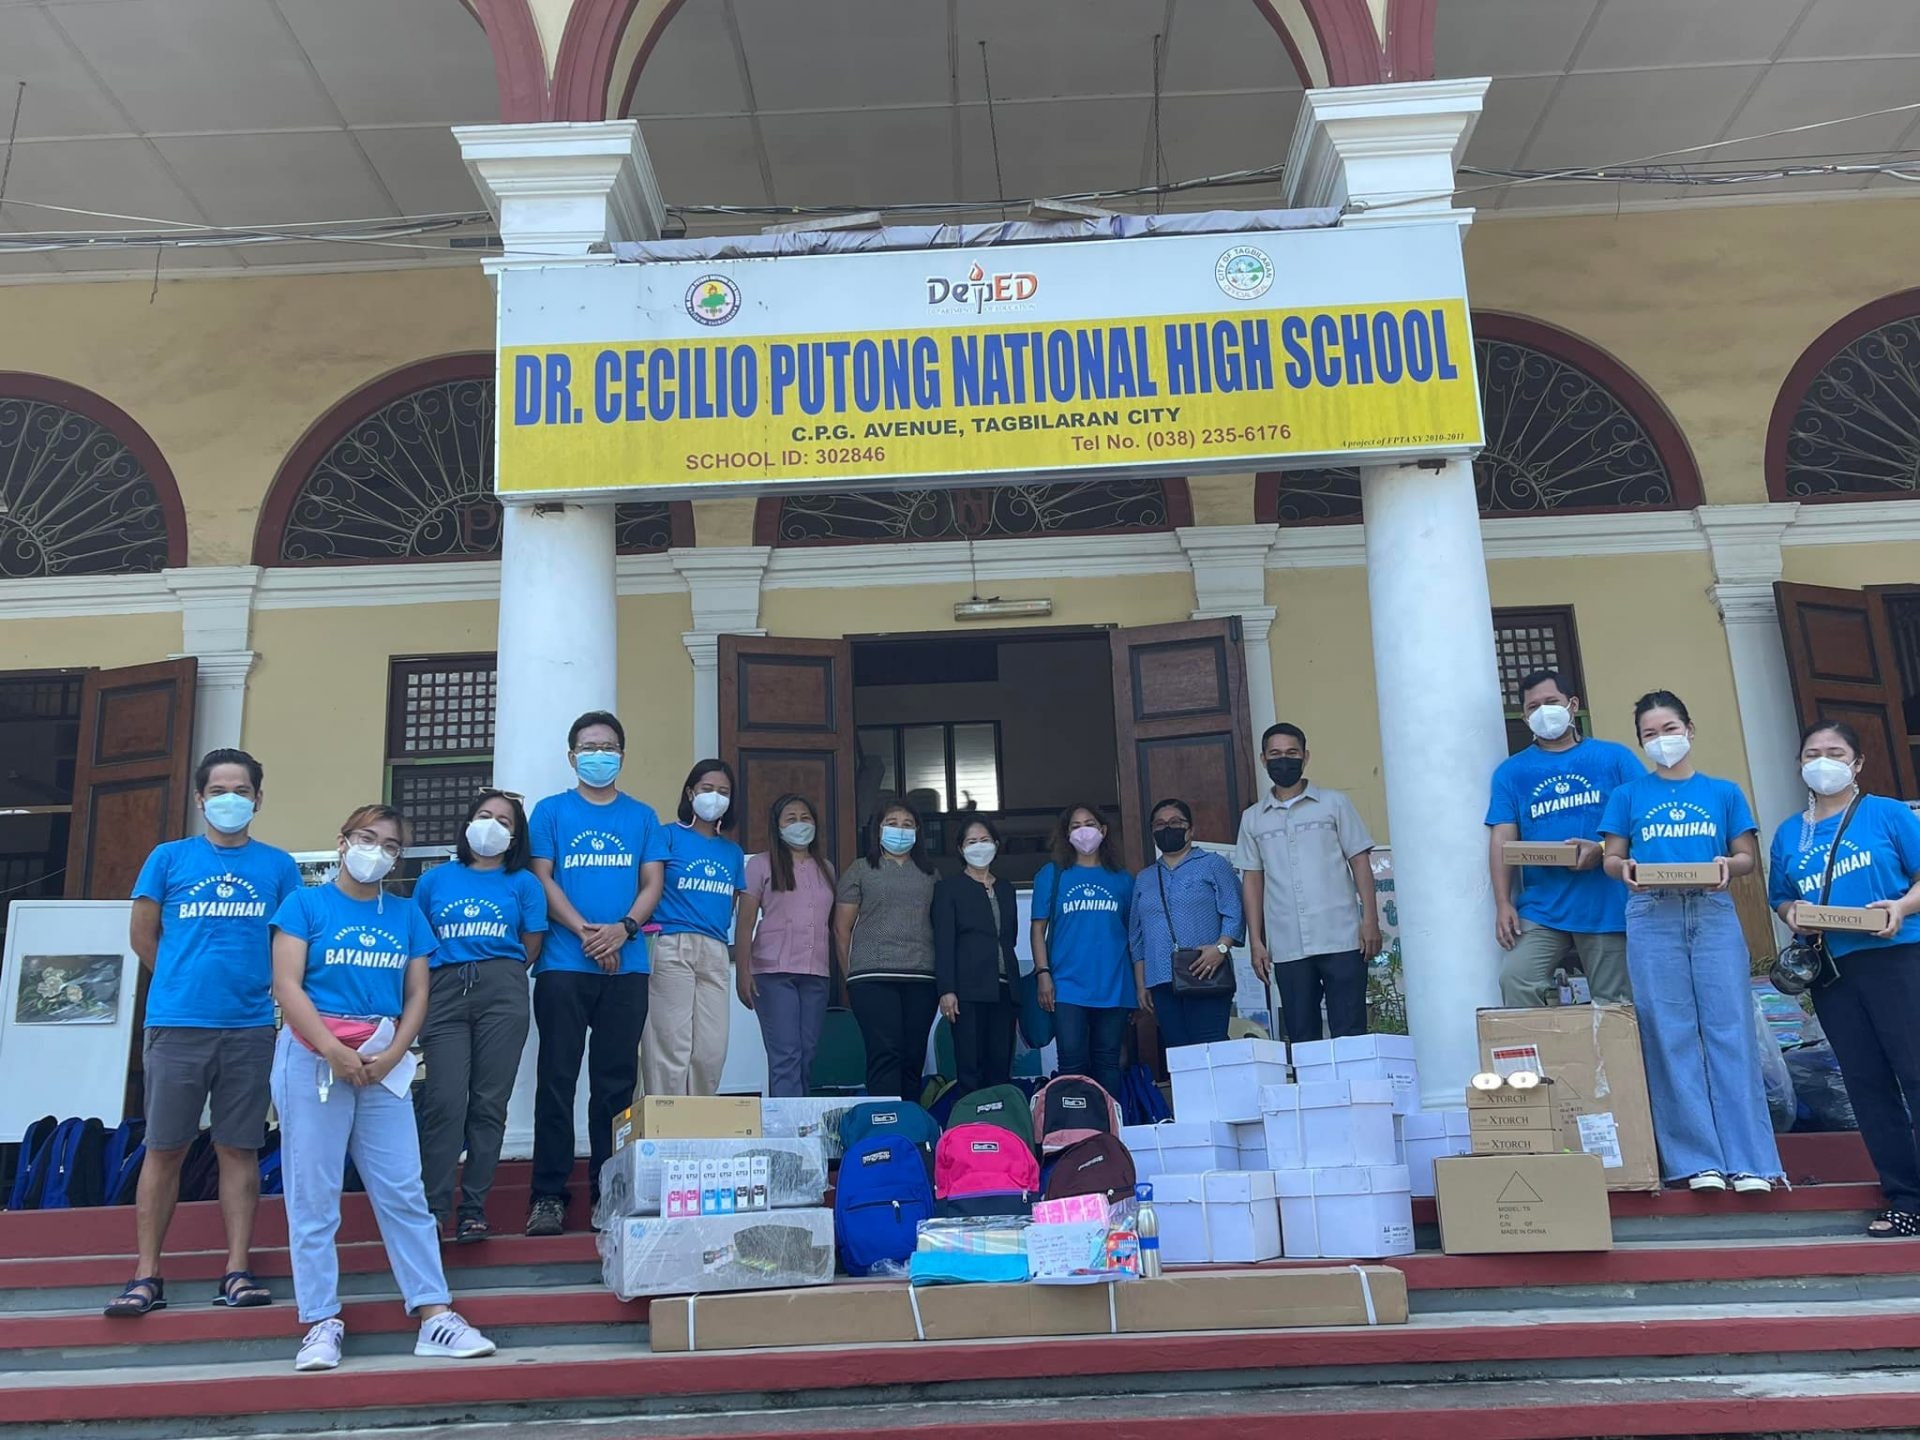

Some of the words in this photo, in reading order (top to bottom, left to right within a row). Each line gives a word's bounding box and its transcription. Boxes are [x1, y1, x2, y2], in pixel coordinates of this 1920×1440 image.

[514, 355, 583, 425] DR.
[594, 343, 757, 424] CECILIO
[770, 338, 940, 414] PUTONG
[952, 325, 1157, 408] NATIONAL
[1165, 318, 1273, 395] HIGH
[1281, 308, 1458, 388] SCHOOL
[791, 425, 855, 442] C.P.G.
[864, 419, 964, 438] AVENUE,
[971, 411, 1119, 433] TAGBILARAN
[1127, 407, 1181, 425] CITY
[1071, 436, 1100, 451] Tel
[1107, 434, 1140, 450] No.
[1146, 430, 1196, 452] (038)
[1201, 424, 1292, 445] 235-6176
[1347, 439, 1375, 449] project
[1376, 437, 1385, 446] of
[1425, 433, 1465, 442] 2010-2011
[686, 451, 775, 471] SCHOOL
[782, 449, 809, 466] ID:
[816, 446, 885, 465] 302846
[1531, 790, 1600, 818] BAYANIHAN
[1641, 821, 1717, 842] BAYANIHAN
[563, 854, 633, 869] BAYANIHAN
[1521, 852, 1557, 862] XTORCH
[1656, 870, 1698, 879] XTORCH
[1798, 850, 1872, 895] BAYNIHAN
[677, 876, 735, 896] BAYANIHAN
[179, 901, 267, 919] BAYANIHAN
[1062, 899, 1119, 914] BAYANIHAN
[1819, 913, 1863, 925] XTORCH
[325, 947, 408, 969] BAYANIHAN
[1487, 1094, 1527, 1104] XTORCH
[1489, 1115, 1529, 1125] XTORCH
[1491, 1139, 1531, 1149] XTORCH
